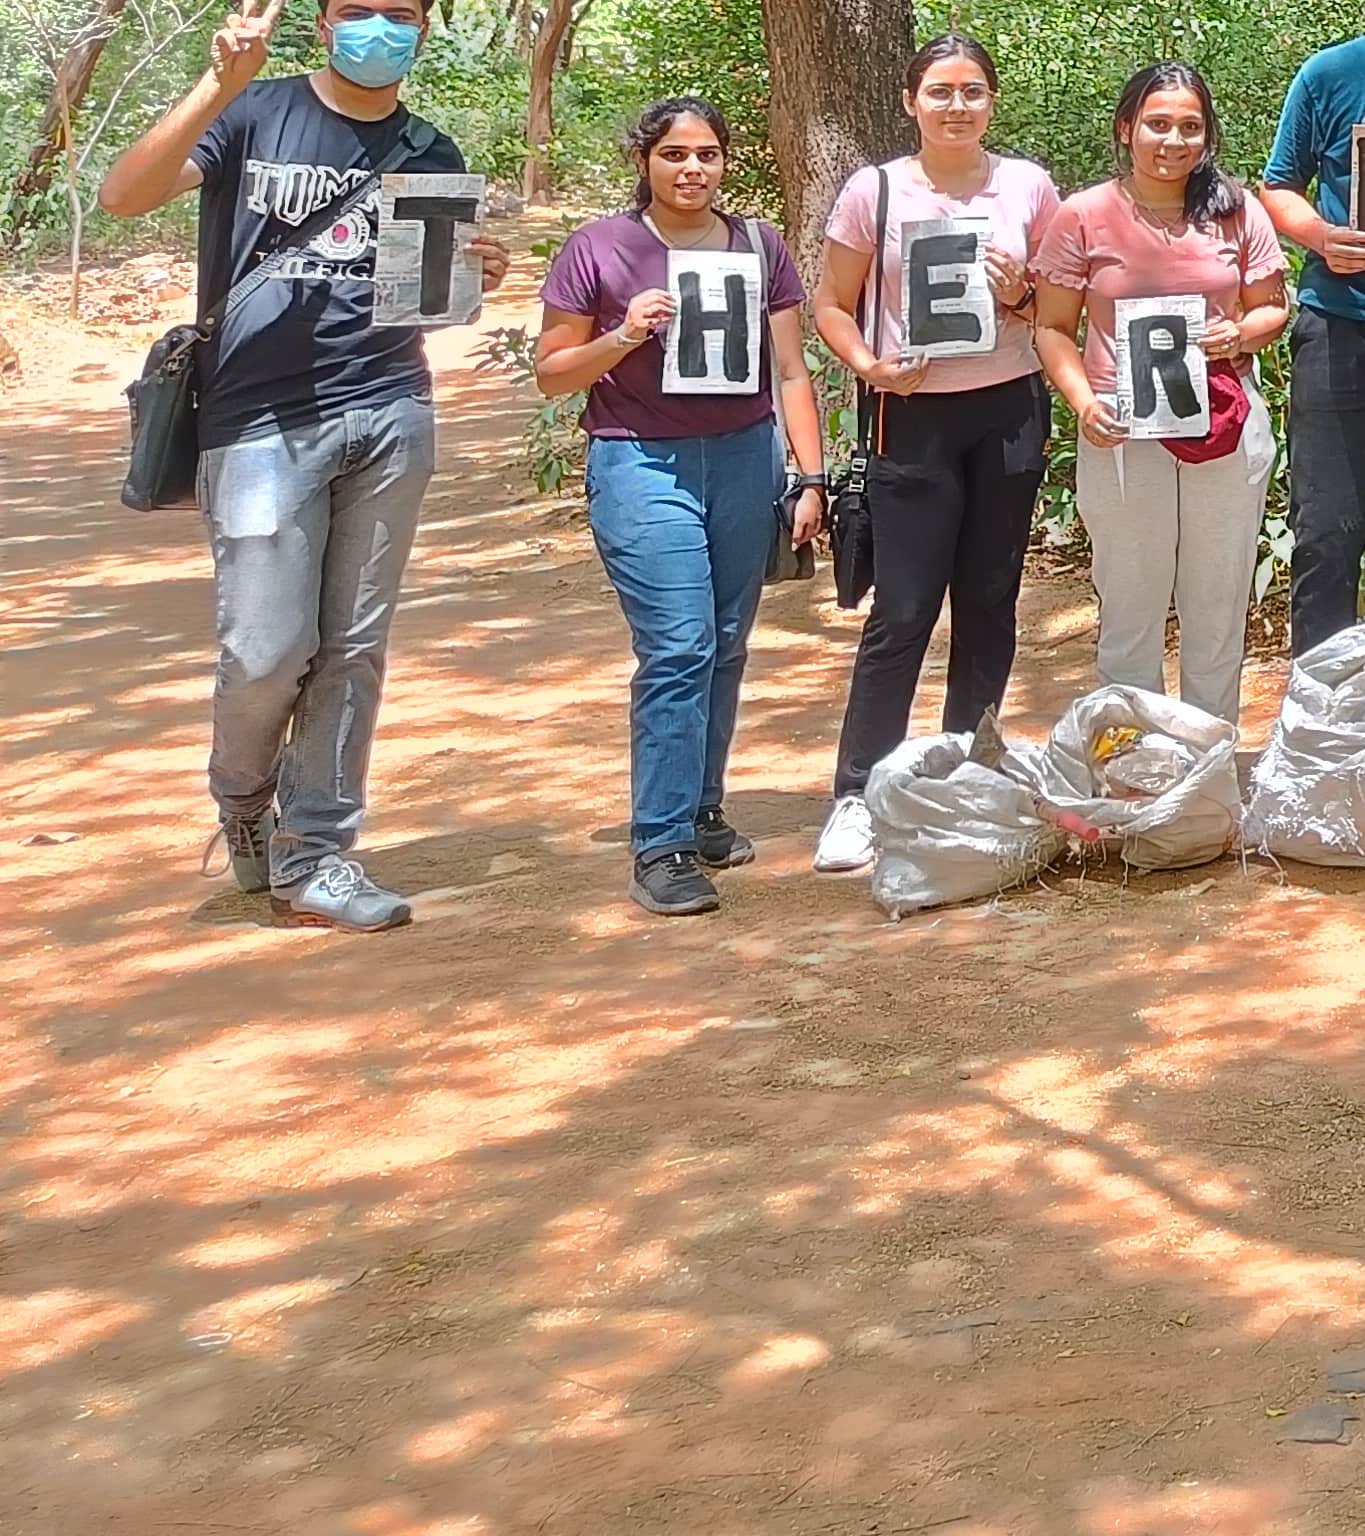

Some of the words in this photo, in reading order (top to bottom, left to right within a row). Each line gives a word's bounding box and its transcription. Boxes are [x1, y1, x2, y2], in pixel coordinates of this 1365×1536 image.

[393, 196, 480, 315] T
[909, 232, 983, 346] E
[677, 271, 751, 382] H
[1128, 314, 1202, 420] R
